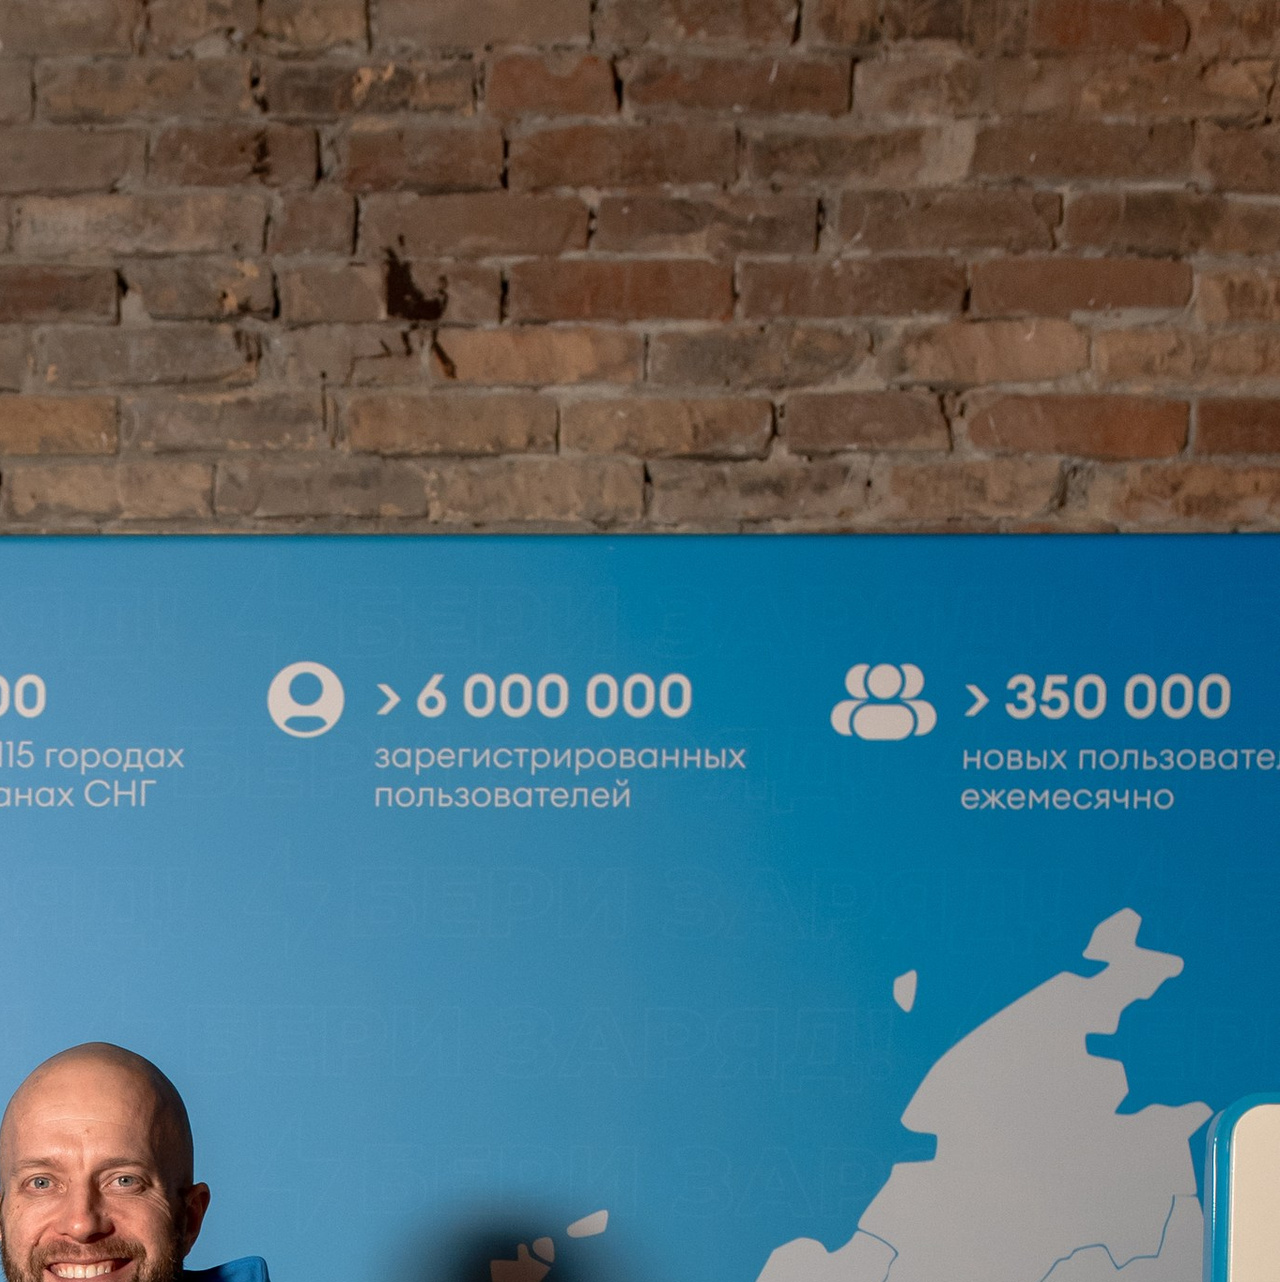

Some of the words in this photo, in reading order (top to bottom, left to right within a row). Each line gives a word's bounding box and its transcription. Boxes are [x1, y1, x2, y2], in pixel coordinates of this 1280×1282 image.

[415, 672, 447, 719] 6
[461, 672, 575, 719] 000
[585, 672, 693, 719] 000
[1003, 672, 1108, 720] 350
[1121, 672, 1232, 720] 000
[44, 744, 185, 777] городах
[373, 741, 747, 777] зарегистрированных
[961, 746, 1067, 772] новых
[83, 779, 157, 808] СНГ
[373, 777, 633, 811] пользователей
[959, 786, 1175, 812] ежемесячно
